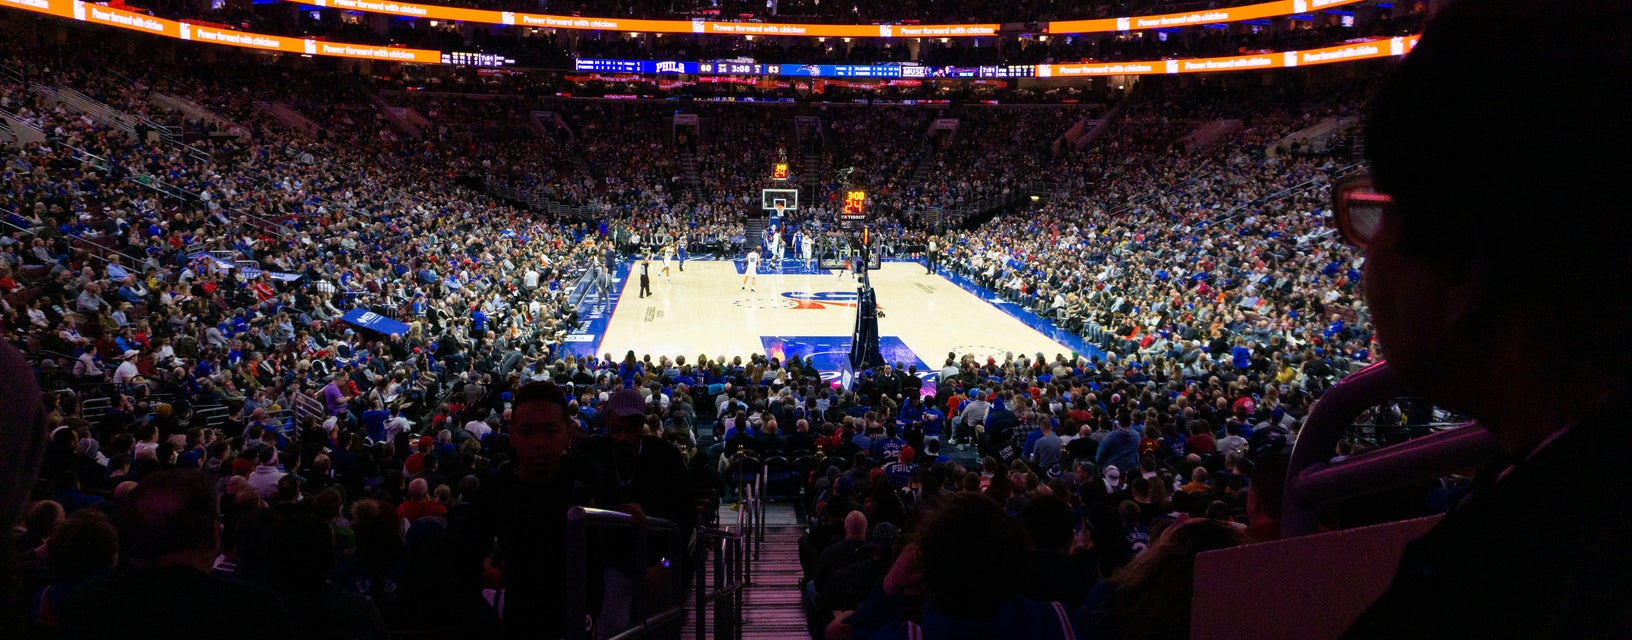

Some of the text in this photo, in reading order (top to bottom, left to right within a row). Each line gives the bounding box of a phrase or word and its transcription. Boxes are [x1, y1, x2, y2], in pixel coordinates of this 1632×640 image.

[358, 0, 386, 10] forward
[385, 4, 400, 12] with
[400, 6, 427, 15] chicken
[524, 16, 546, 24] Power
[546, 18, 574, 27] forward
[590, 21, 617, 29] chicken
[779, 26, 805, 34] chicken
[198, 29, 279, 47] Power forward with chicken
[323, 45, 415, 59] Power forward with chicken
[656, 62, 685, 73] PHILA
[1082, 66, 1109, 74] forward
[774, 169, 786, 177] 24
[848, 192, 864, 200] 3:08
[844, 200, 862, 213] 24
[892, 464, 910, 472] PHIL
